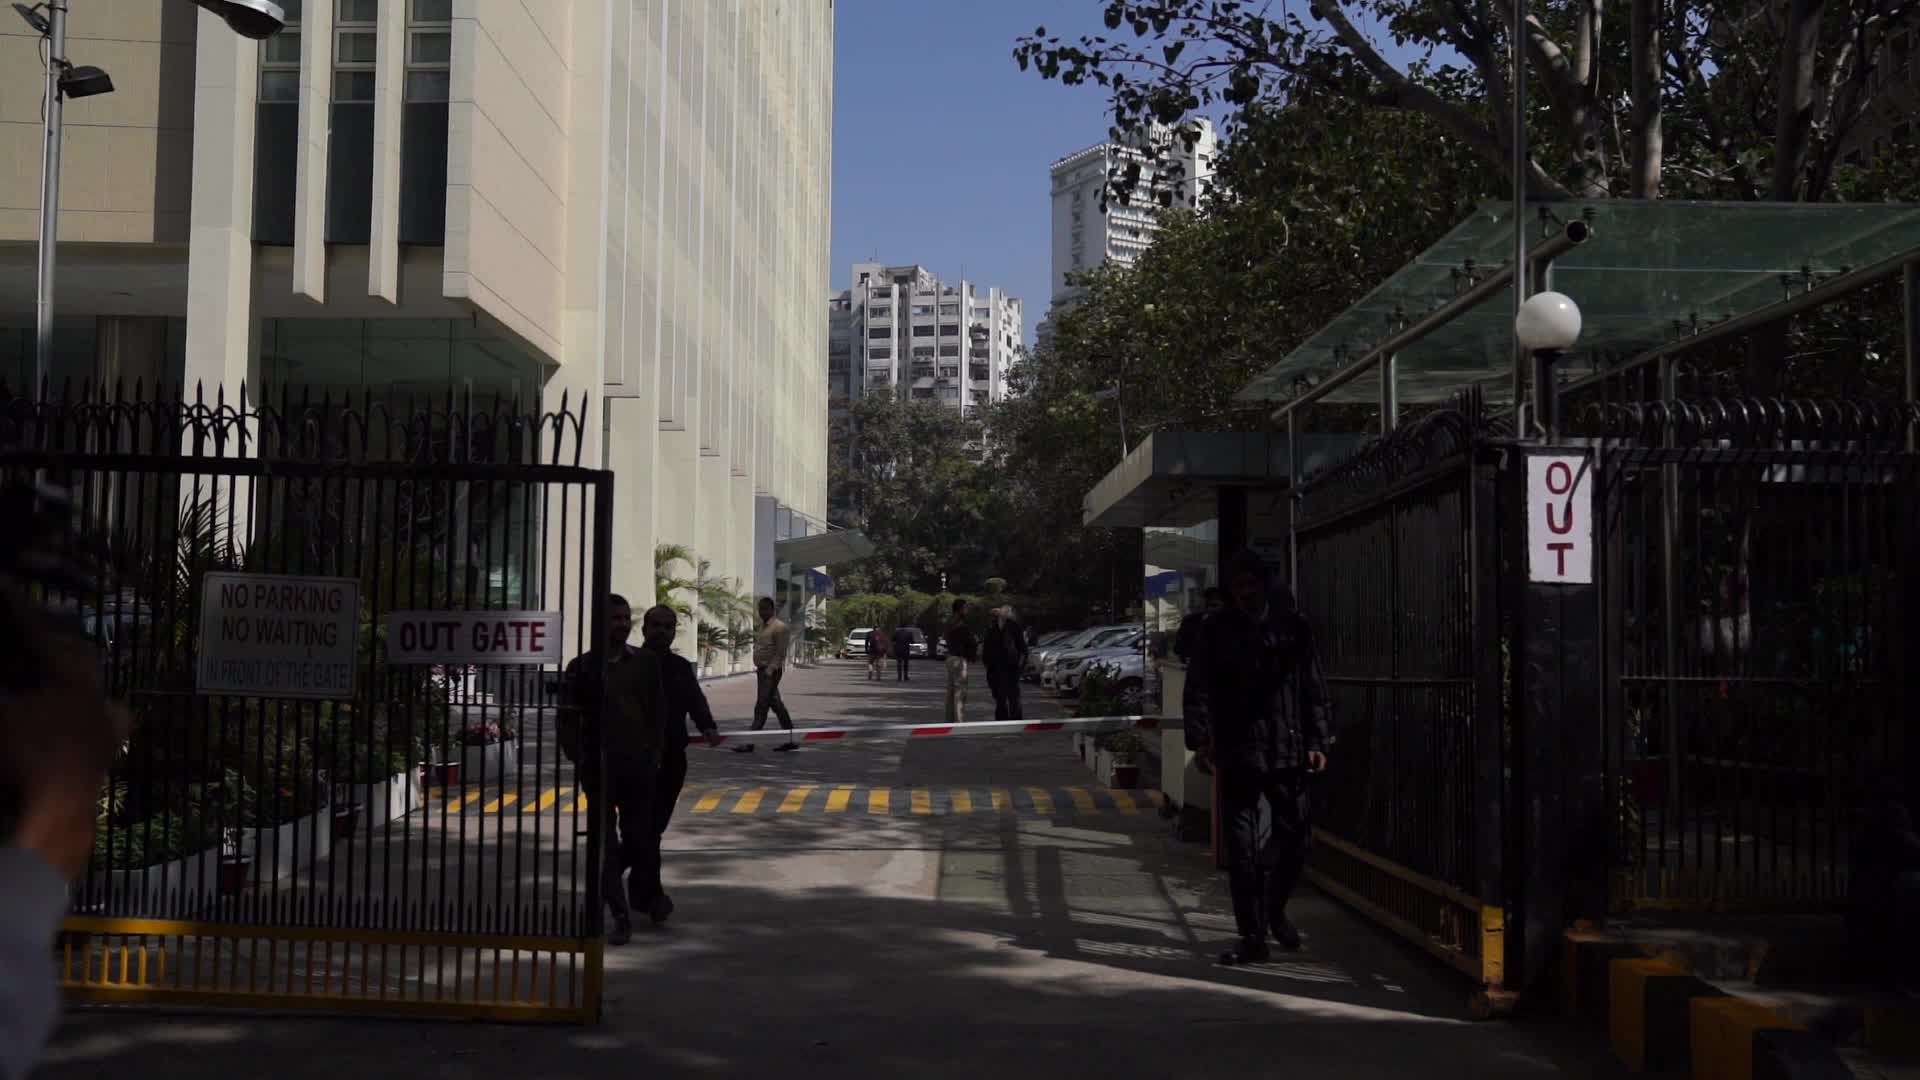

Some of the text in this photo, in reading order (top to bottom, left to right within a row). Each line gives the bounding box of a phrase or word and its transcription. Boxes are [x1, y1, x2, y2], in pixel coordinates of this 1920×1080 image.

[1546, 461, 1574, 576] OUT
[221, 583, 342, 613] NO PARKING
[221, 618, 337, 647] NO WAITING
[400, 621, 546, 652] OUT GATE
[221, 659, 262, 685] FRONT
[264, 660, 281, 686] OF
[286, 661, 312, 688] THE
[313, 662, 349, 689] GATE
